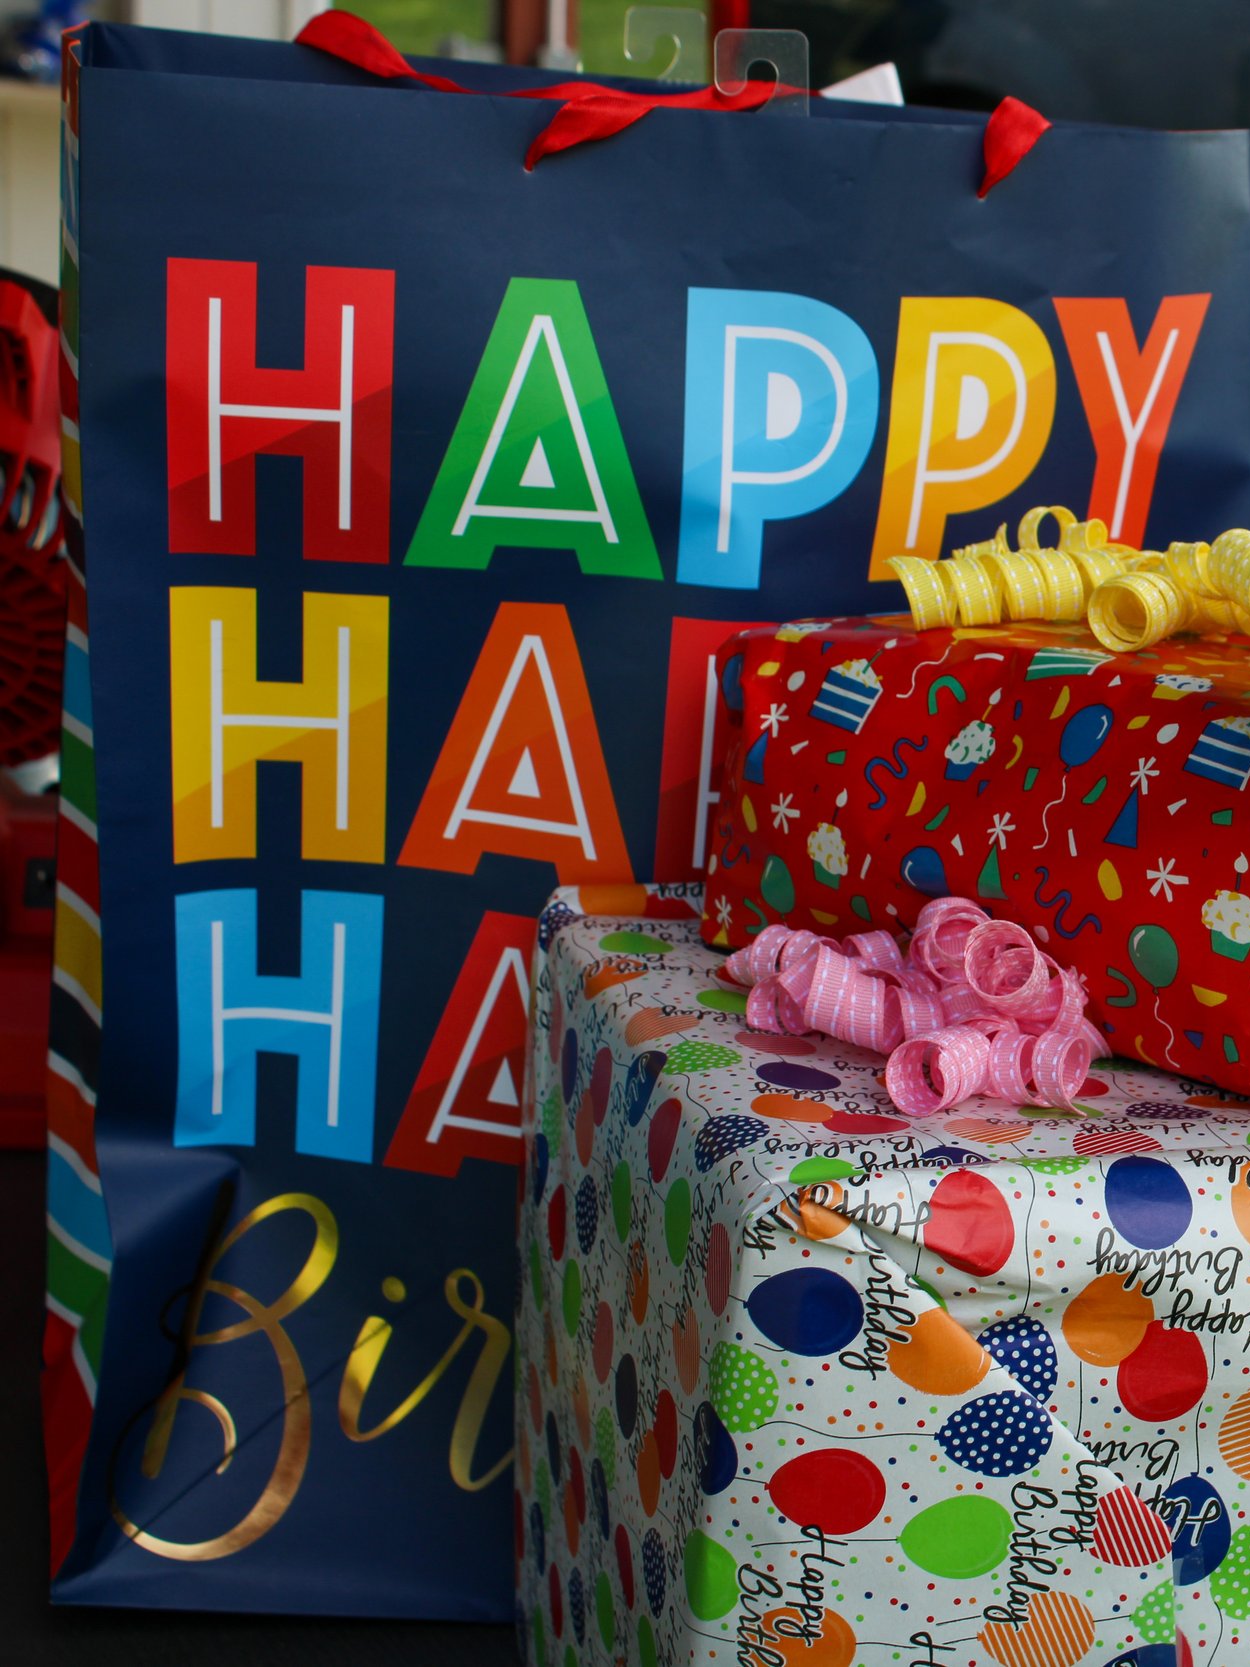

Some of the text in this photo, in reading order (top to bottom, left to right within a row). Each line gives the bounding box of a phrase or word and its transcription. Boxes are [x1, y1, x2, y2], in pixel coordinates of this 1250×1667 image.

[165, 256, 1213, 589] HAPPY
[758, 1136, 916, 1159] Birthday
[1078, 1120, 1197, 1135] Happy
[1086, 1226, 1243, 1297] Birthday
[773, 1523, 849, 1648] Happy
[983, 1481, 1058, 1632] Birthday
